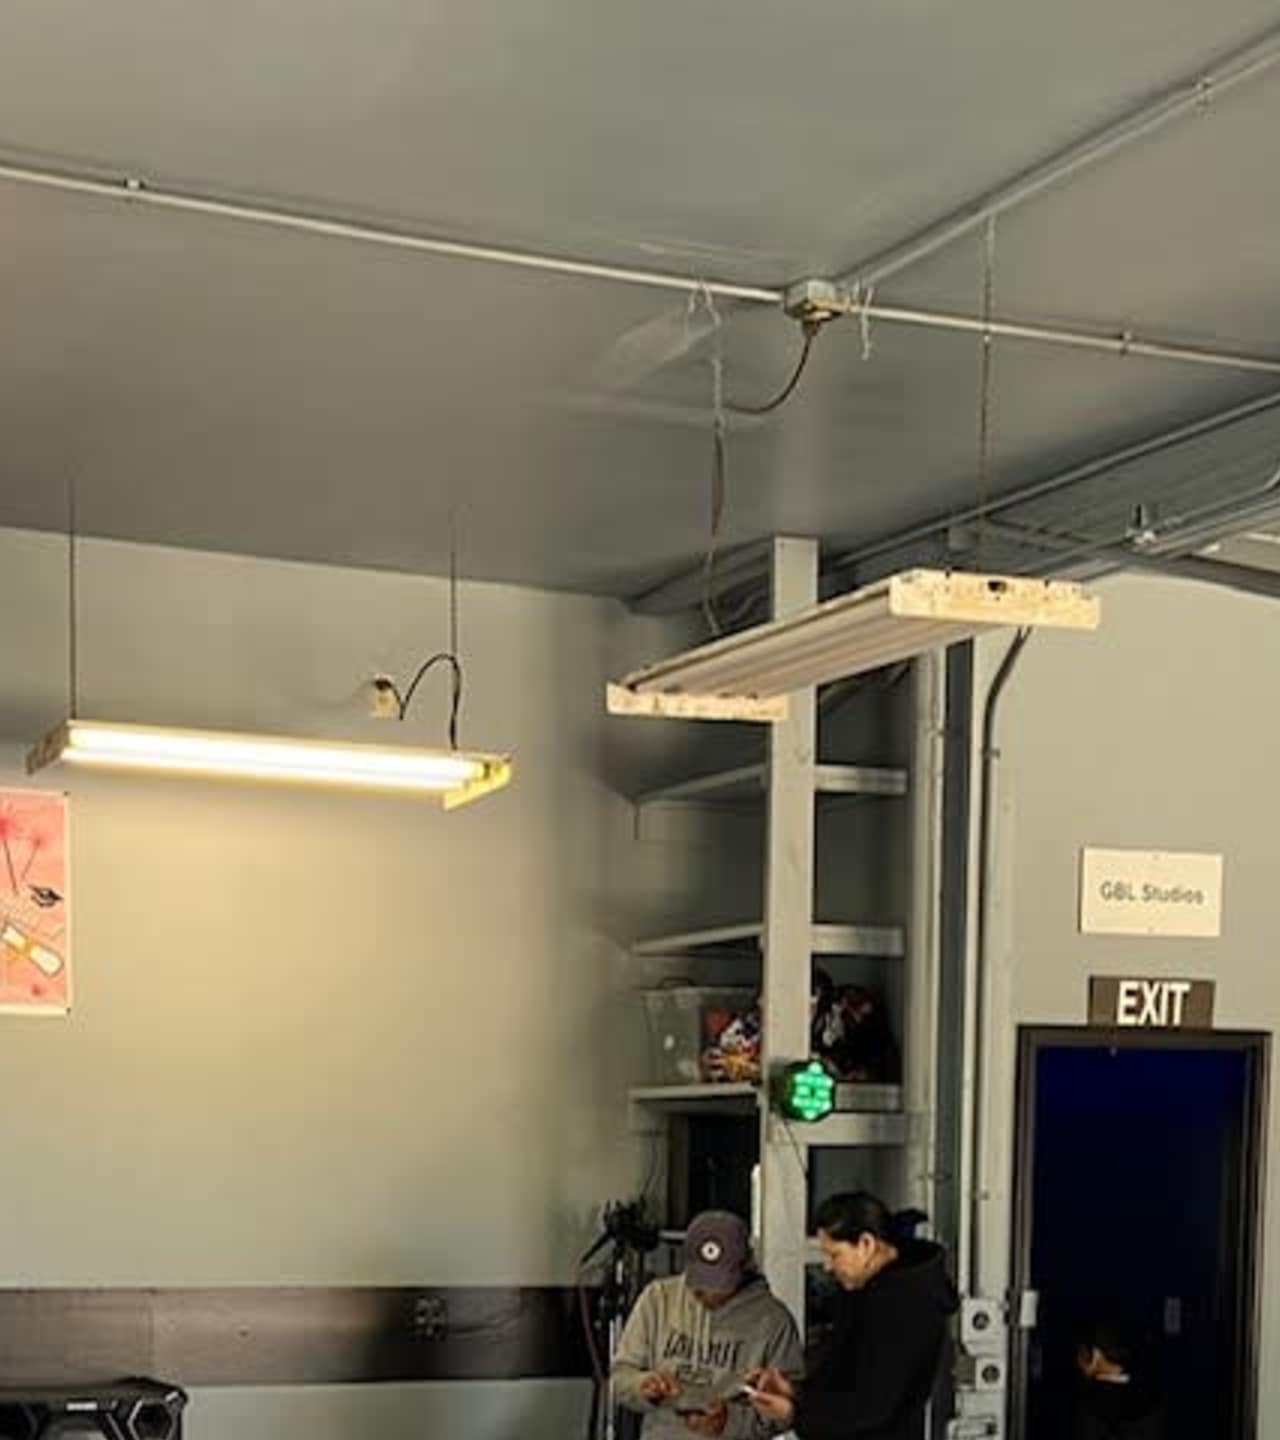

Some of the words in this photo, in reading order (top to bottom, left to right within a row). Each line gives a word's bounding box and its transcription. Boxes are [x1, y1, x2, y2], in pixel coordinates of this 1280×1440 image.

[1099, 880, 1137, 902] GBL
[1141, 882, 1205, 906] Studios
[1116, 980, 1192, 1027] EXIT
